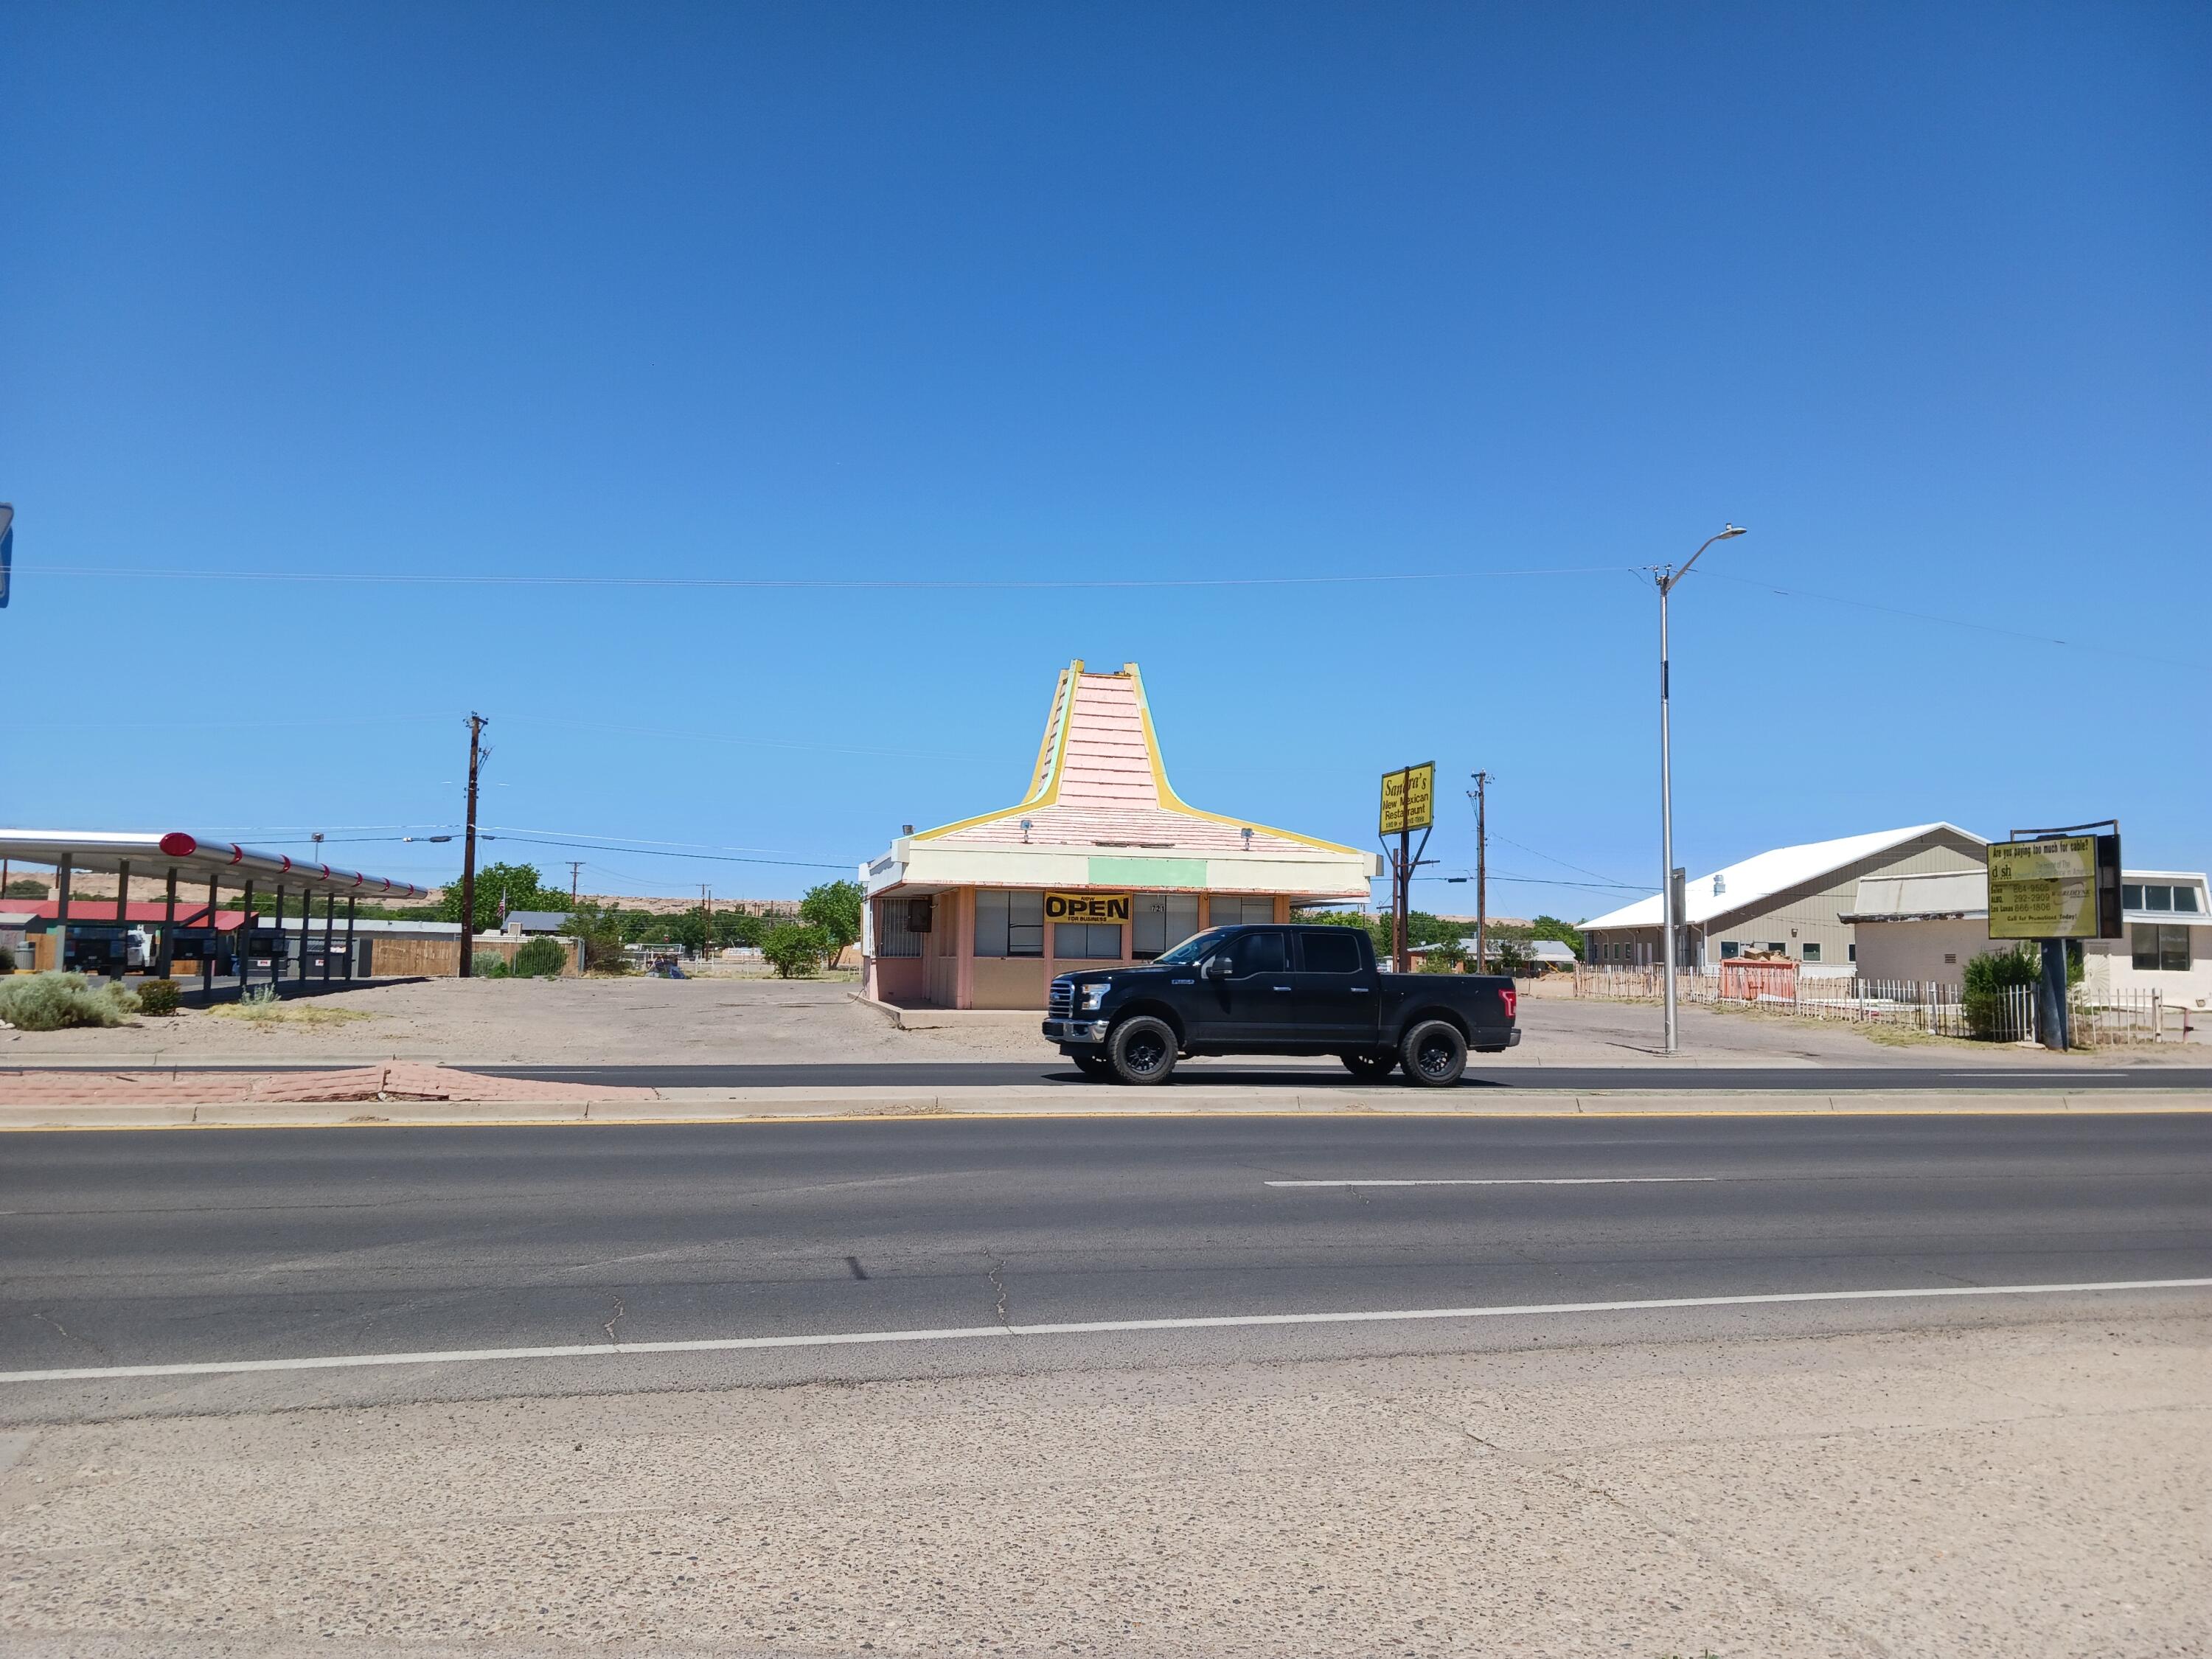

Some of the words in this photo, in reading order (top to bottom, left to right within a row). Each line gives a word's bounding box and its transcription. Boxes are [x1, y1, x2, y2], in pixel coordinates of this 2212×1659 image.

[1382, 799, 1397, 810] New
[1385, 803, 1425, 821] Restaraunt
[1992, 847, 2002, 858] Are
[2003, 848, 2013, 859] you
[2014, 846, 2031, 859] paying
[2033, 844, 2042, 855] too
[2043, 842, 2058, 853] much
[2060, 841, 2068, 852] for
[2070, 839, 2089, 852] cable?
[1992, 864, 2011, 878] dsh
[1046, 896, 1129, 919] OPEN
[1151, 905, 1165, 913] 721
